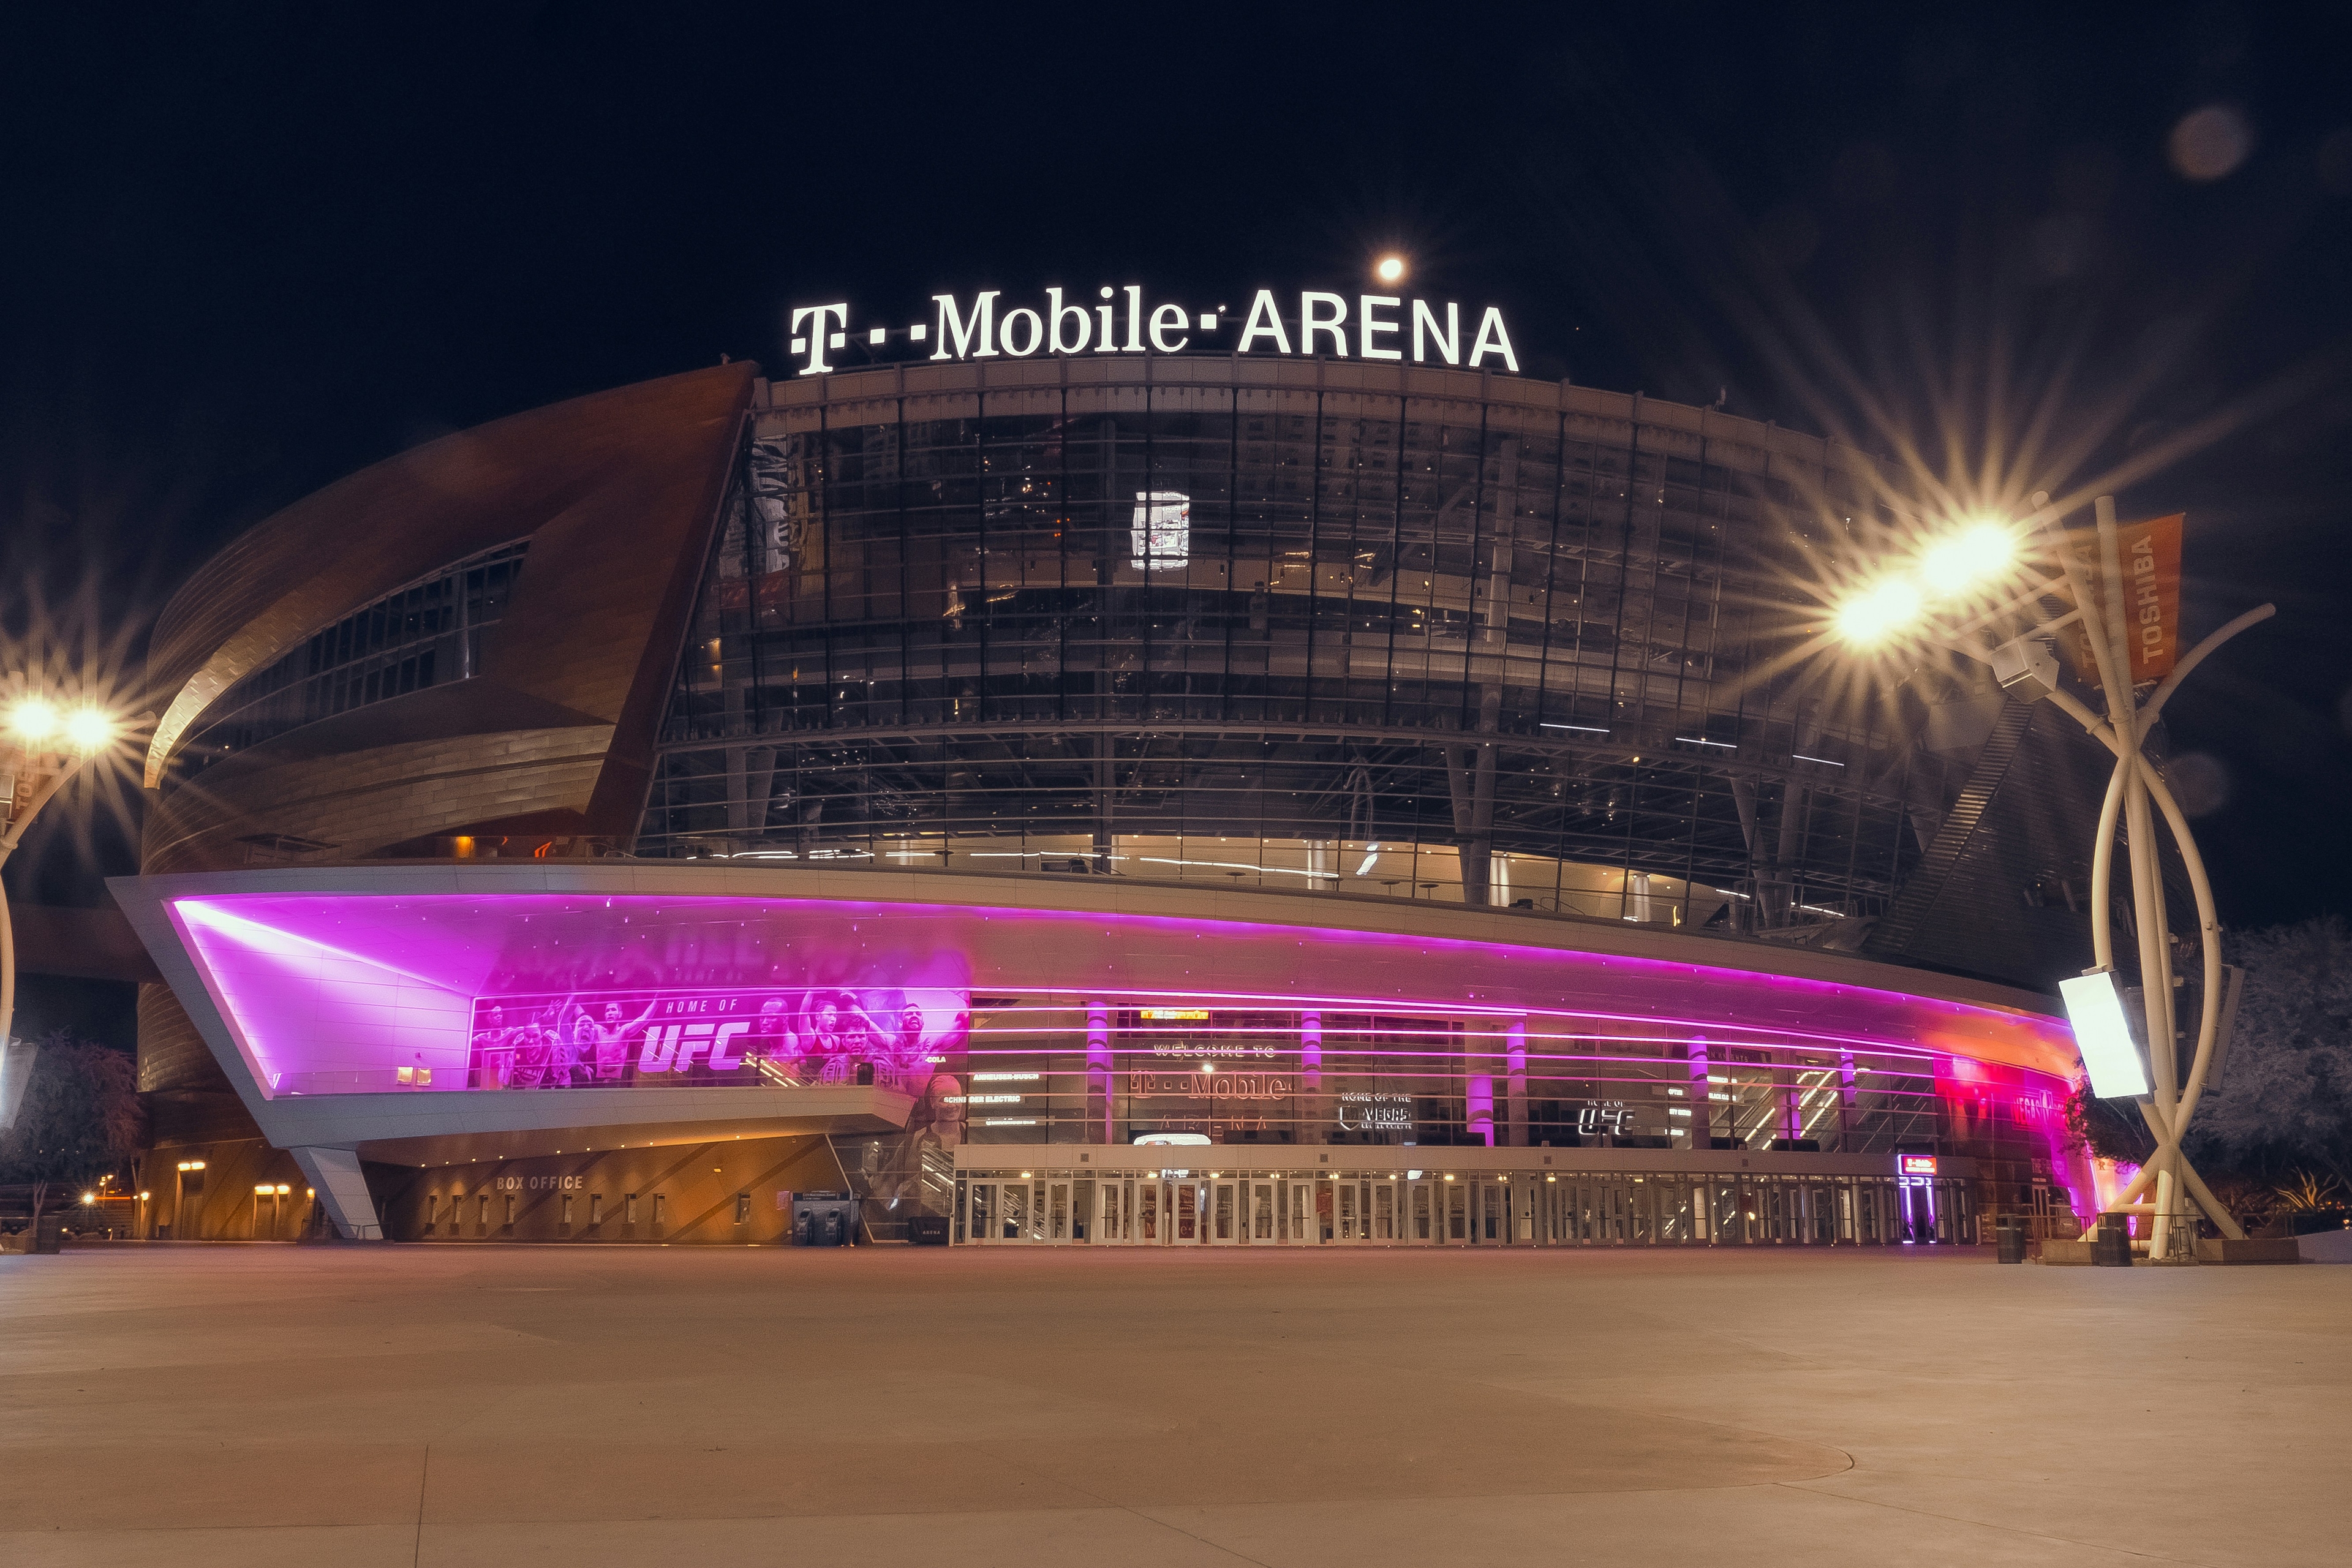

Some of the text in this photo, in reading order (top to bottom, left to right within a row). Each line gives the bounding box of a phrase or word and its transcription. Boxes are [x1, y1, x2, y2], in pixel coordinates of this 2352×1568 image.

[1237, 290, 1520, 372] ARENA
[2132, 535, 2163, 665] TOSHIBA
[666, 998, 737, 1014] HOME OF
[638, 1022, 751, 1072] UFC
[1154, 1044, 1276, 1058] WELCOME TO
[985, 1095, 1021, 1103] ELECTRIC
[1341, 1092, 1372, 1101] HOME
[1365, 1107, 1408, 1121] VEGAS
[1578, 1109, 1636, 1136] UFC
[497, 1175, 582, 1190] BOX OFFICE
